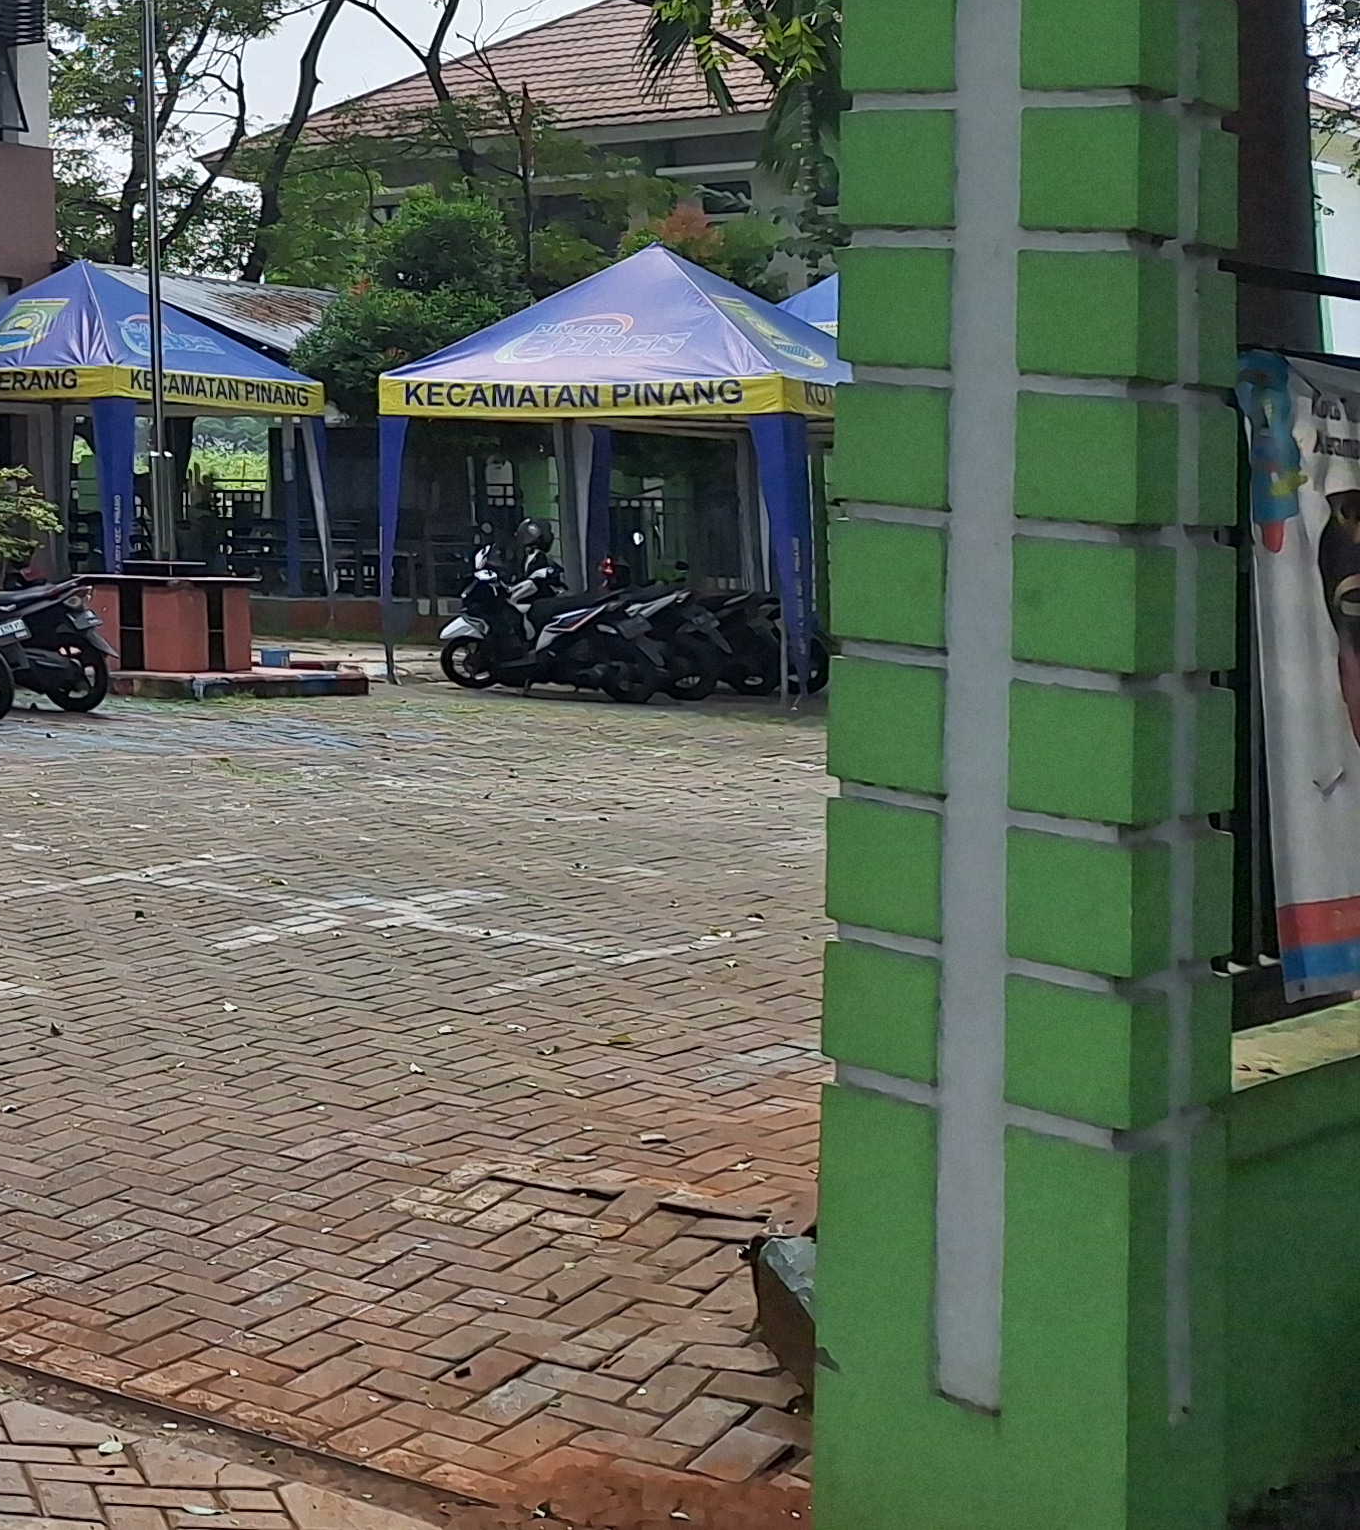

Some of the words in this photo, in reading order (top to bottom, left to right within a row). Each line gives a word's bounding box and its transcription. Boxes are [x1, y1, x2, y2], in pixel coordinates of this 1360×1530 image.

[245, 382, 309, 407] PINANG
[405, 382, 600, 408] KECAMATAN
[612, 379, 743, 408] PINANG
